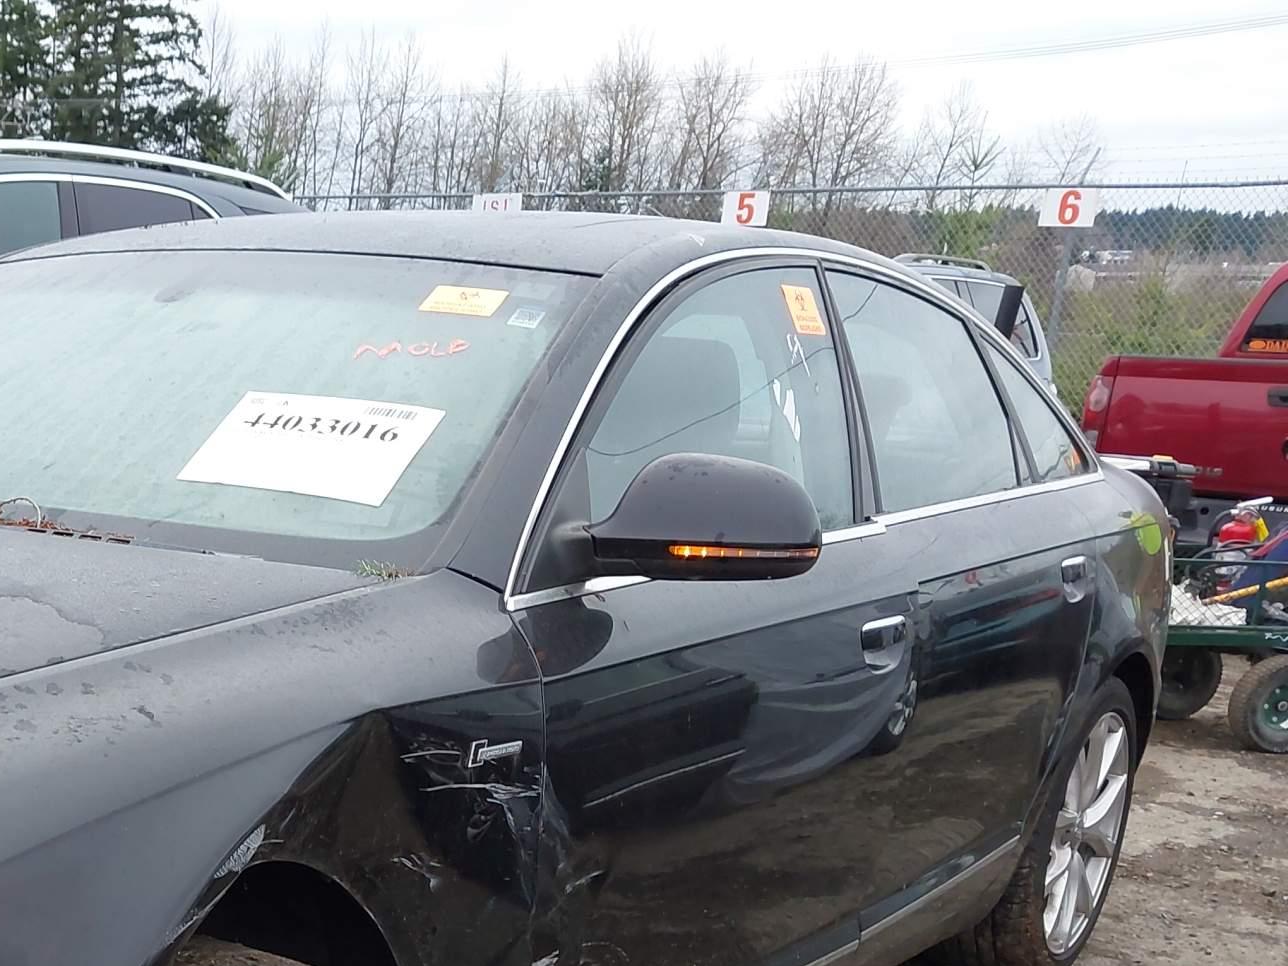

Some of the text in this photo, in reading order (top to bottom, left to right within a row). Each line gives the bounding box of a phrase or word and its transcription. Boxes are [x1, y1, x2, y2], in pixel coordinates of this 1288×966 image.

[736, 193, 756, 224] 5
[1058, 190, 1082, 225] 6
[244, 412, 399, 442] 44033016
